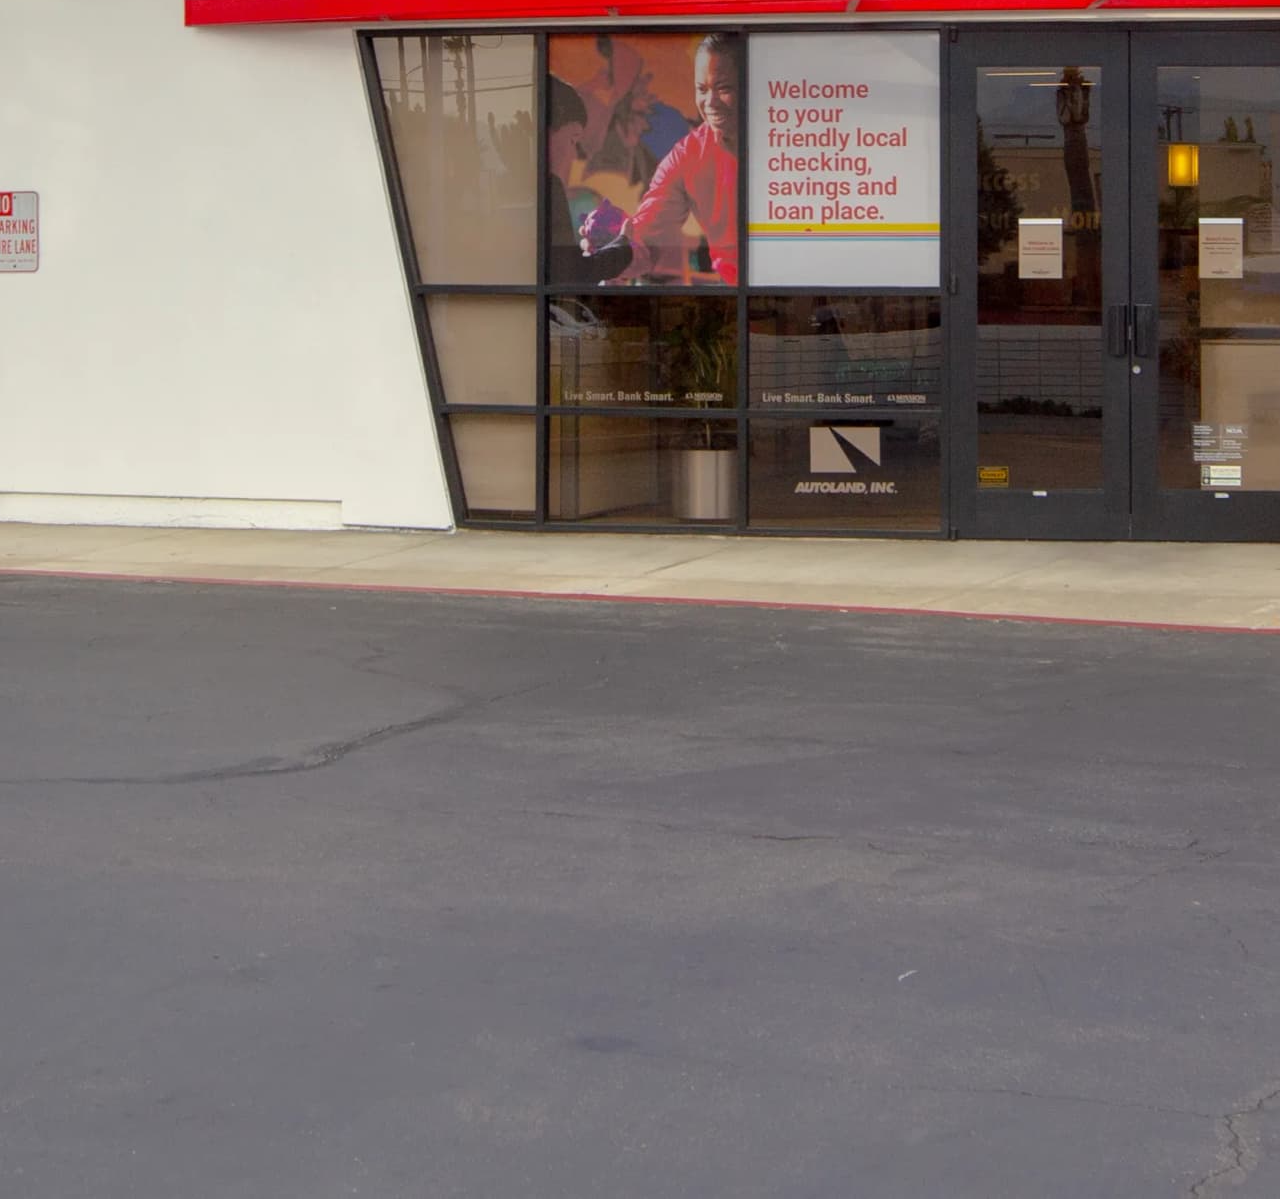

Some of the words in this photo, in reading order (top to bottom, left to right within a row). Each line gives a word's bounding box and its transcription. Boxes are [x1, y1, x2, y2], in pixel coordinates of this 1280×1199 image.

[768, 79, 869, 99] Welcome
[768, 106, 789, 123] to
[795, 108, 843, 128] your
[768, 127, 850, 152] friendly
[857, 127, 907, 147] local
[768, 152, 872, 176] checking,
[768, 177, 850, 200] savings
[857, 176, 897, 196] and
[769, 201, 814, 220] loan
[821, 201, 884, 225] place.
[15, 239, 36, 254] LANE
[565, 391, 583, 401] Live
[586, 391, 616, 401] Smart.
[618, 391, 641, 401] Bank
[643, 391, 674, 402] Smart.
[762, 392, 782, 402] Live
[784, 392, 815, 402] Smart.
[817, 392, 842, 403] Bank
[844, 392, 876, 404] Smart.
[794, 481, 868, 494] AUTOLAND,
[870, 481, 898, 494] INC.
